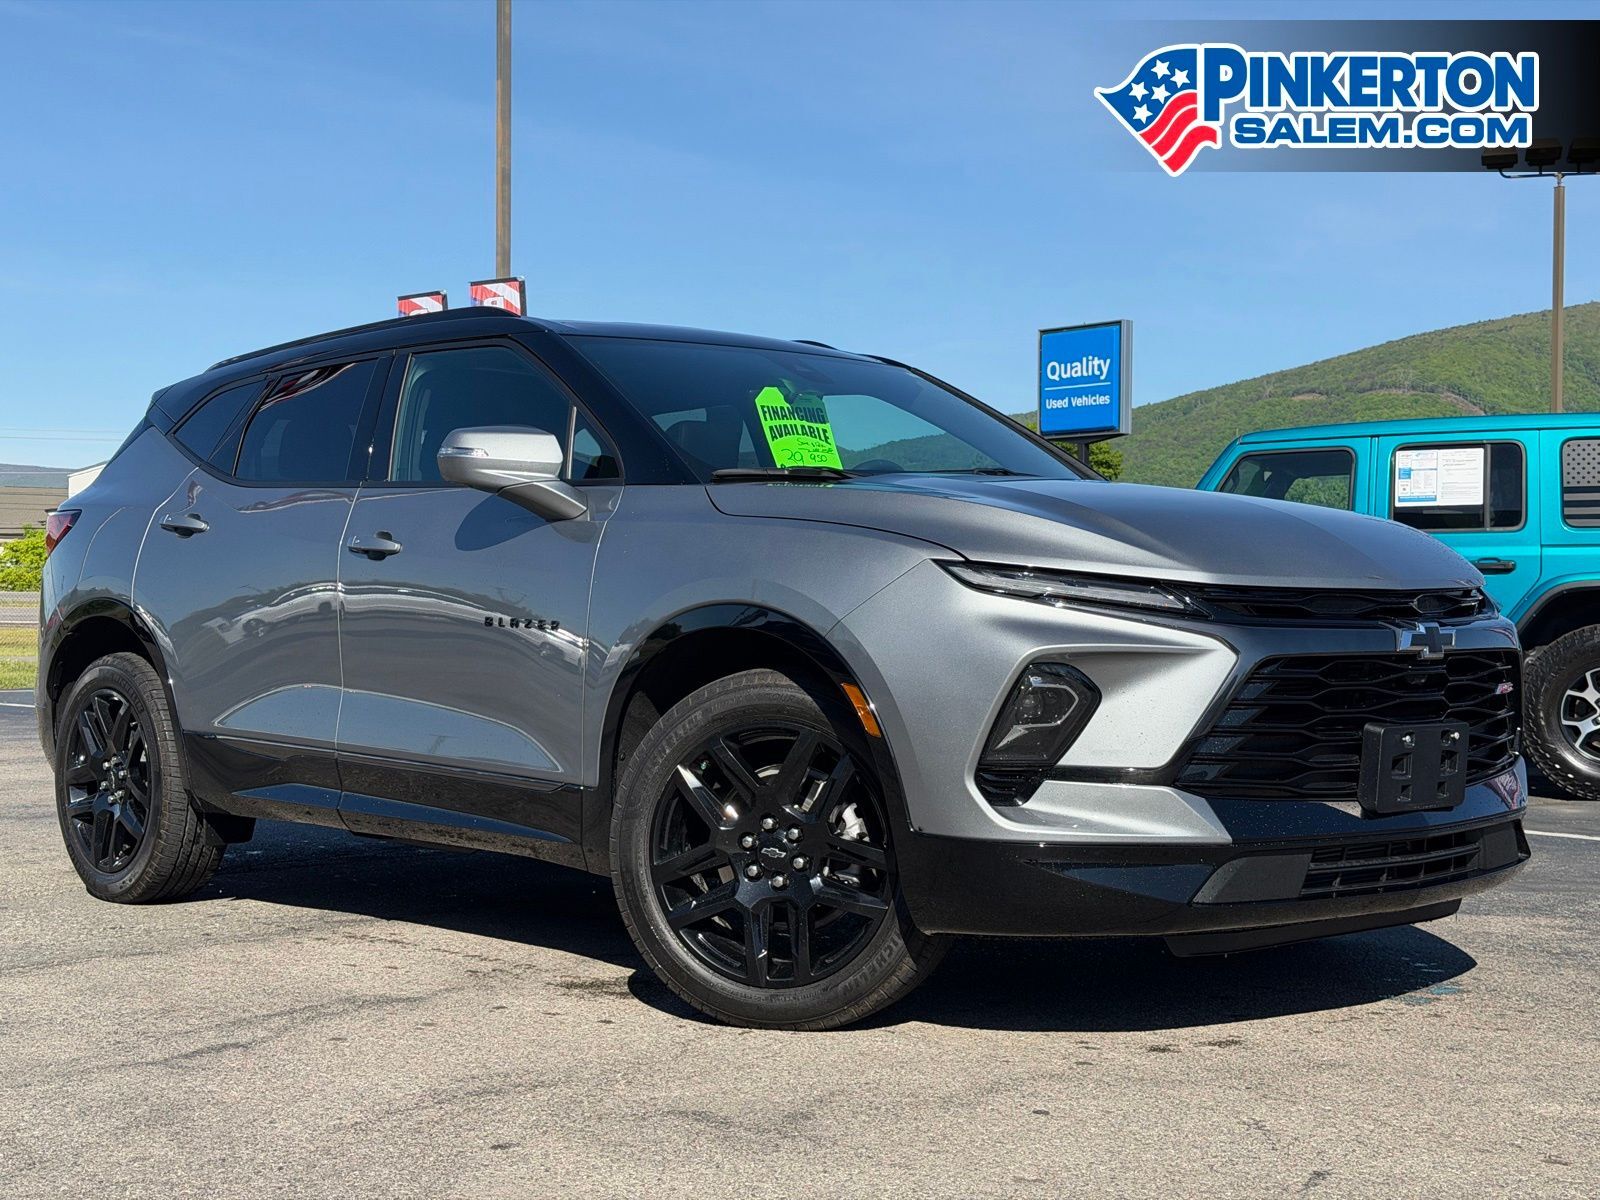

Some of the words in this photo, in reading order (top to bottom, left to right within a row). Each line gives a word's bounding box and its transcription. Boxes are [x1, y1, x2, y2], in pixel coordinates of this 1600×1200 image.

[1047, 356, 1111, 382] Quality
[1046, 397, 1069, 410] Used
[1071, 394, 1111, 408] Vehicles
[760, 404, 828, 424] FINANCING
[769, 424, 832, 446] AVAILABLE
